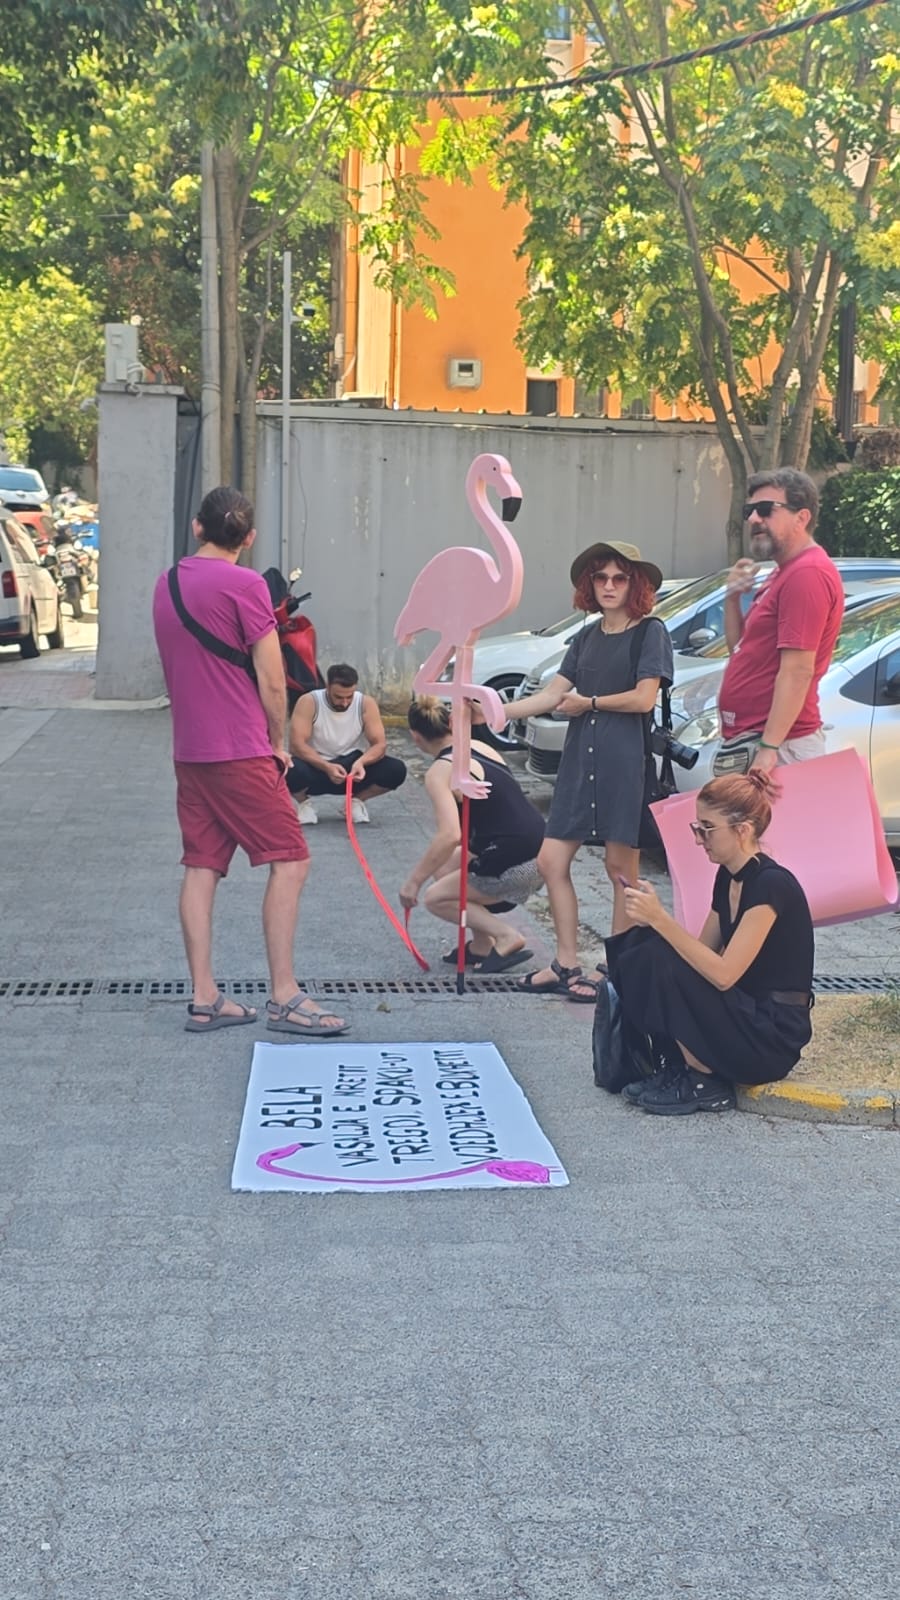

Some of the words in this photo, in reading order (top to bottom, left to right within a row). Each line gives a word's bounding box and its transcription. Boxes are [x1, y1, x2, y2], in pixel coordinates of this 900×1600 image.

[260, 1086, 322, 1129] BELA
[439, 1090, 480, 1099] E
[332, 1104, 366, 1112] E
[332, 1117, 379, 1167] VASALJA
